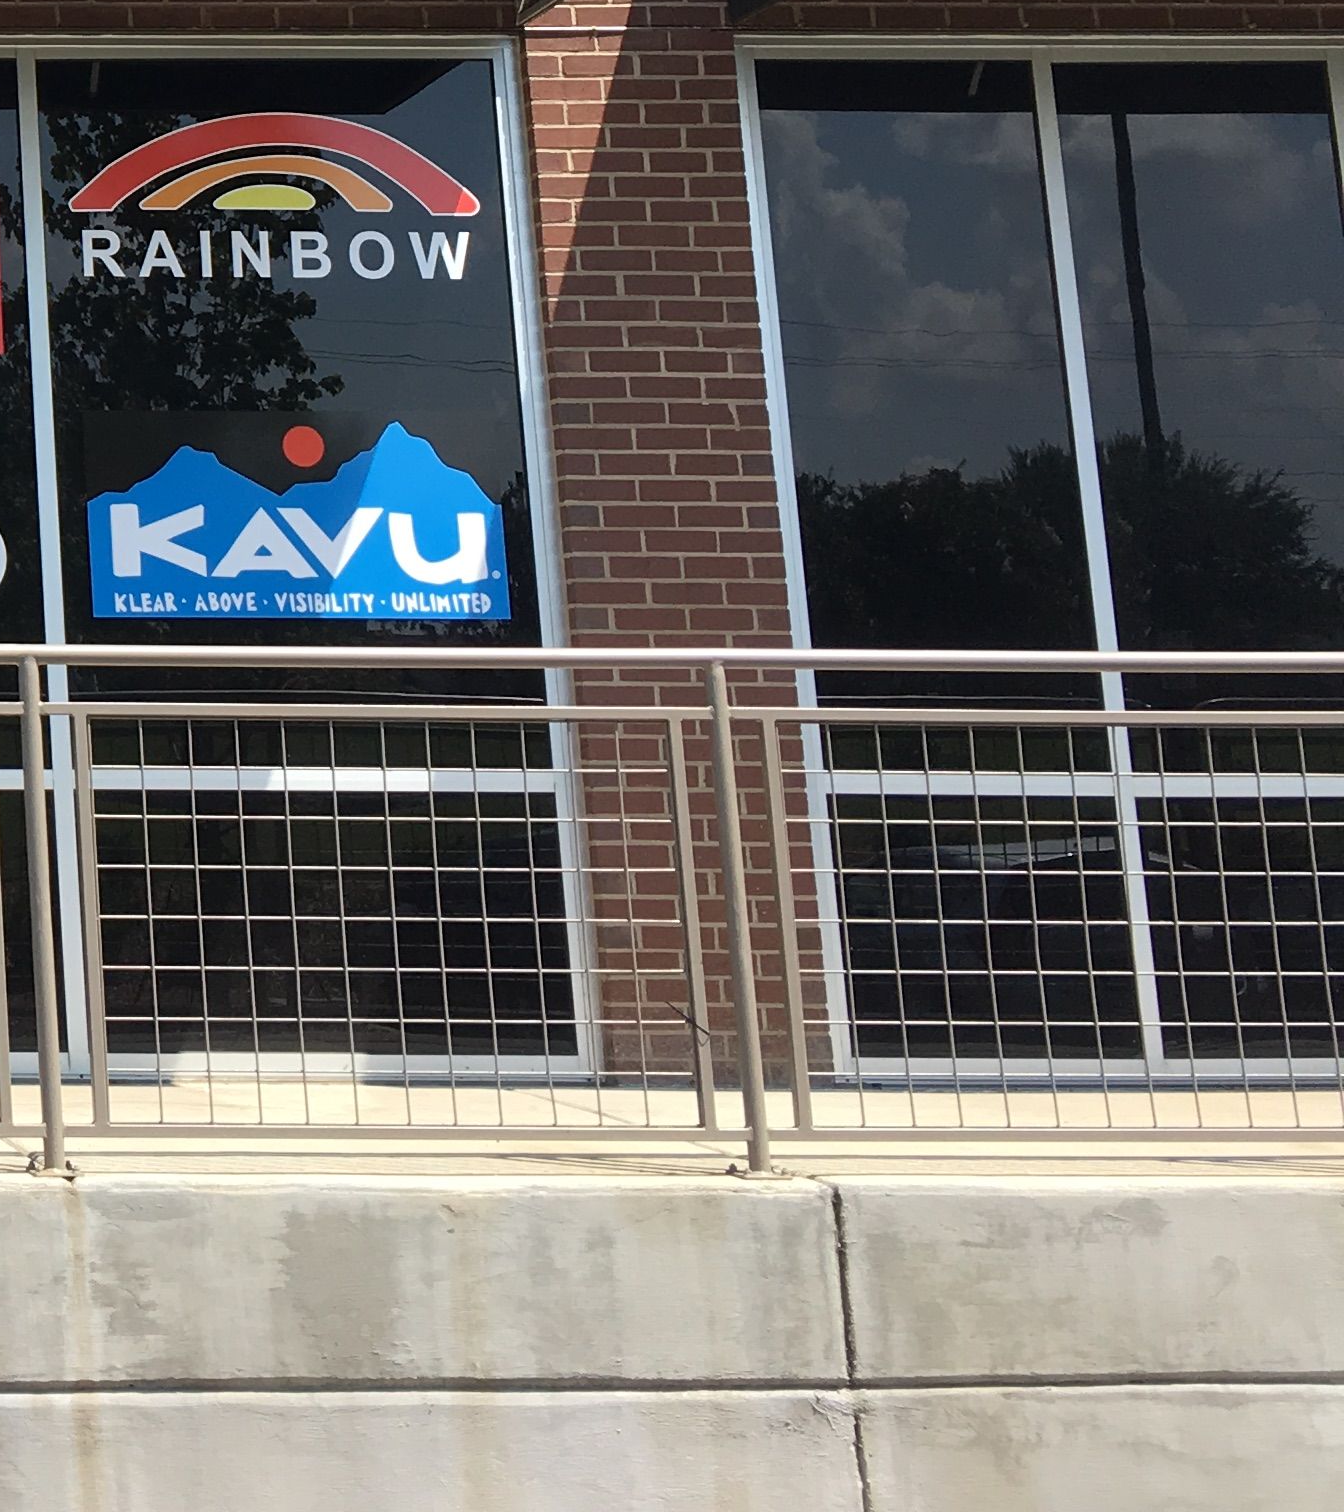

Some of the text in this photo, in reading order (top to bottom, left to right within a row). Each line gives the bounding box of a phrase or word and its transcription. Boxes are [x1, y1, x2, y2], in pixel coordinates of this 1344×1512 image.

[80, 228, 470, 280] RAINBOW
[113, 591, 493, 615] KLEAR ABOVE VISIBILITY UNLIMITED
